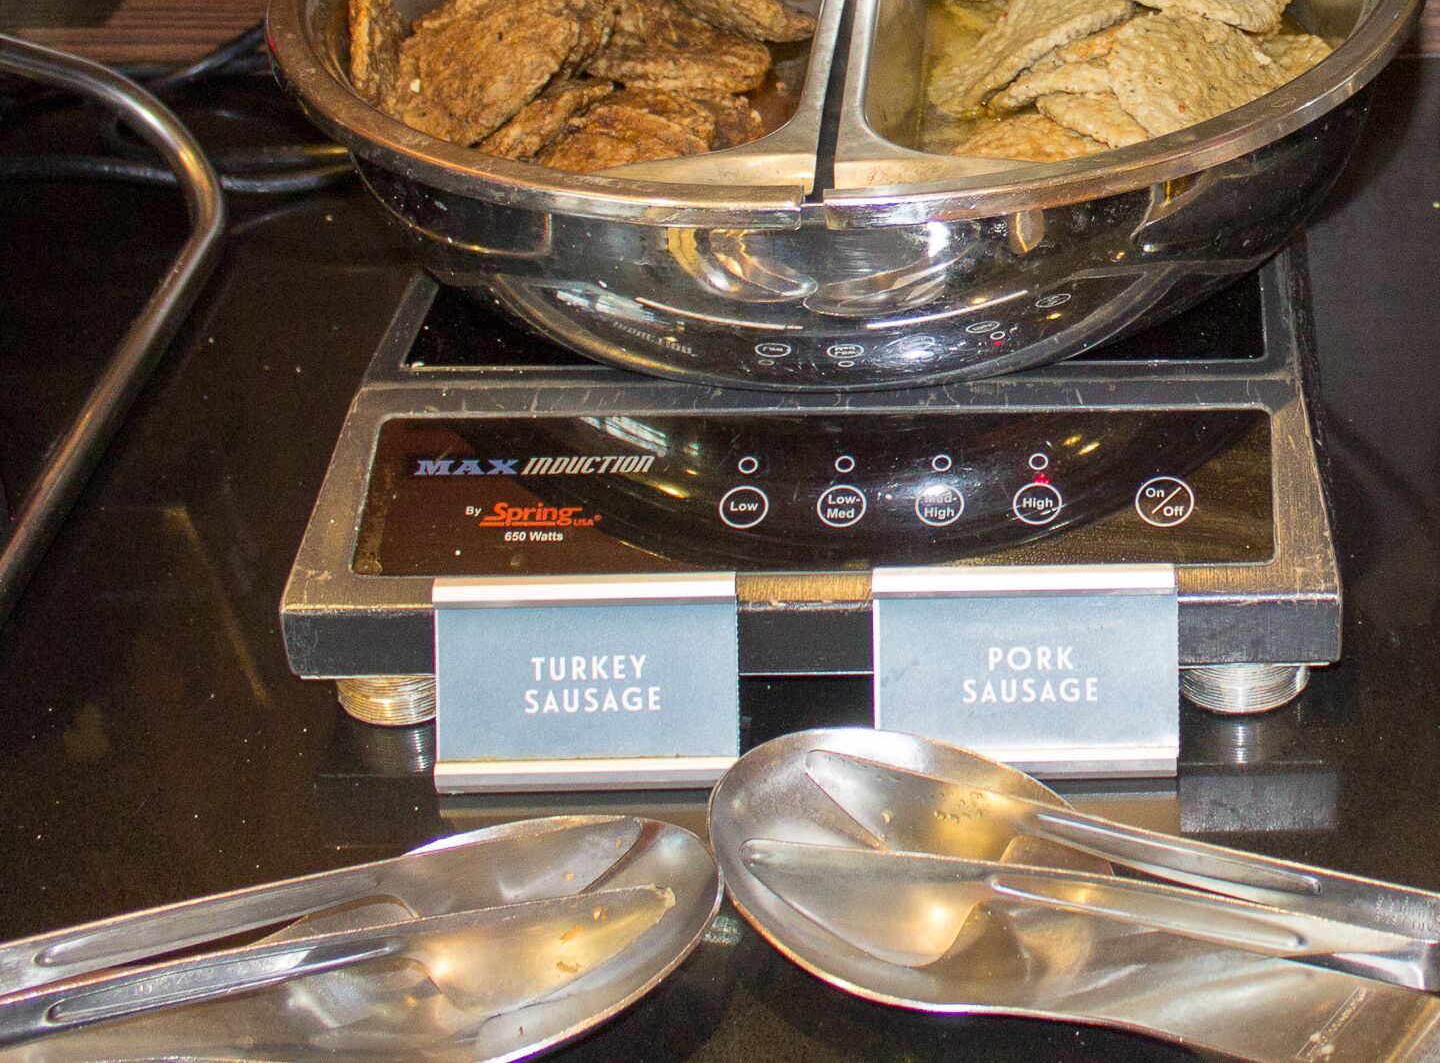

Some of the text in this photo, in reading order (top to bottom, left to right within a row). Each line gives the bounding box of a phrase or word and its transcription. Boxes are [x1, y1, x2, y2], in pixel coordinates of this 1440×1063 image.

[413, 455, 656, 476] MAX INDUCTION
[1145, 487, 1165, 499] On
[729, 501, 759, 513] Low
[827, 494, 861, 507] Low-
[1021, 496, 1054, 512] High
[465, 504, 482, 518] By
[482, 502, 583, 527] Spring
[826, 508, 855, 520] Med
[924, 507, 955, 520] High
[1163, 505, 1185, 518] Off
[504, 531, 564, 542] 650 Watts
[987, 646, 1075, 672] PORK
[531, 654, 648, 682] TURKEY
[961, 677, 1099, 705] SAUSAGE
[523, 686, 662, 715] SAUSAGE
